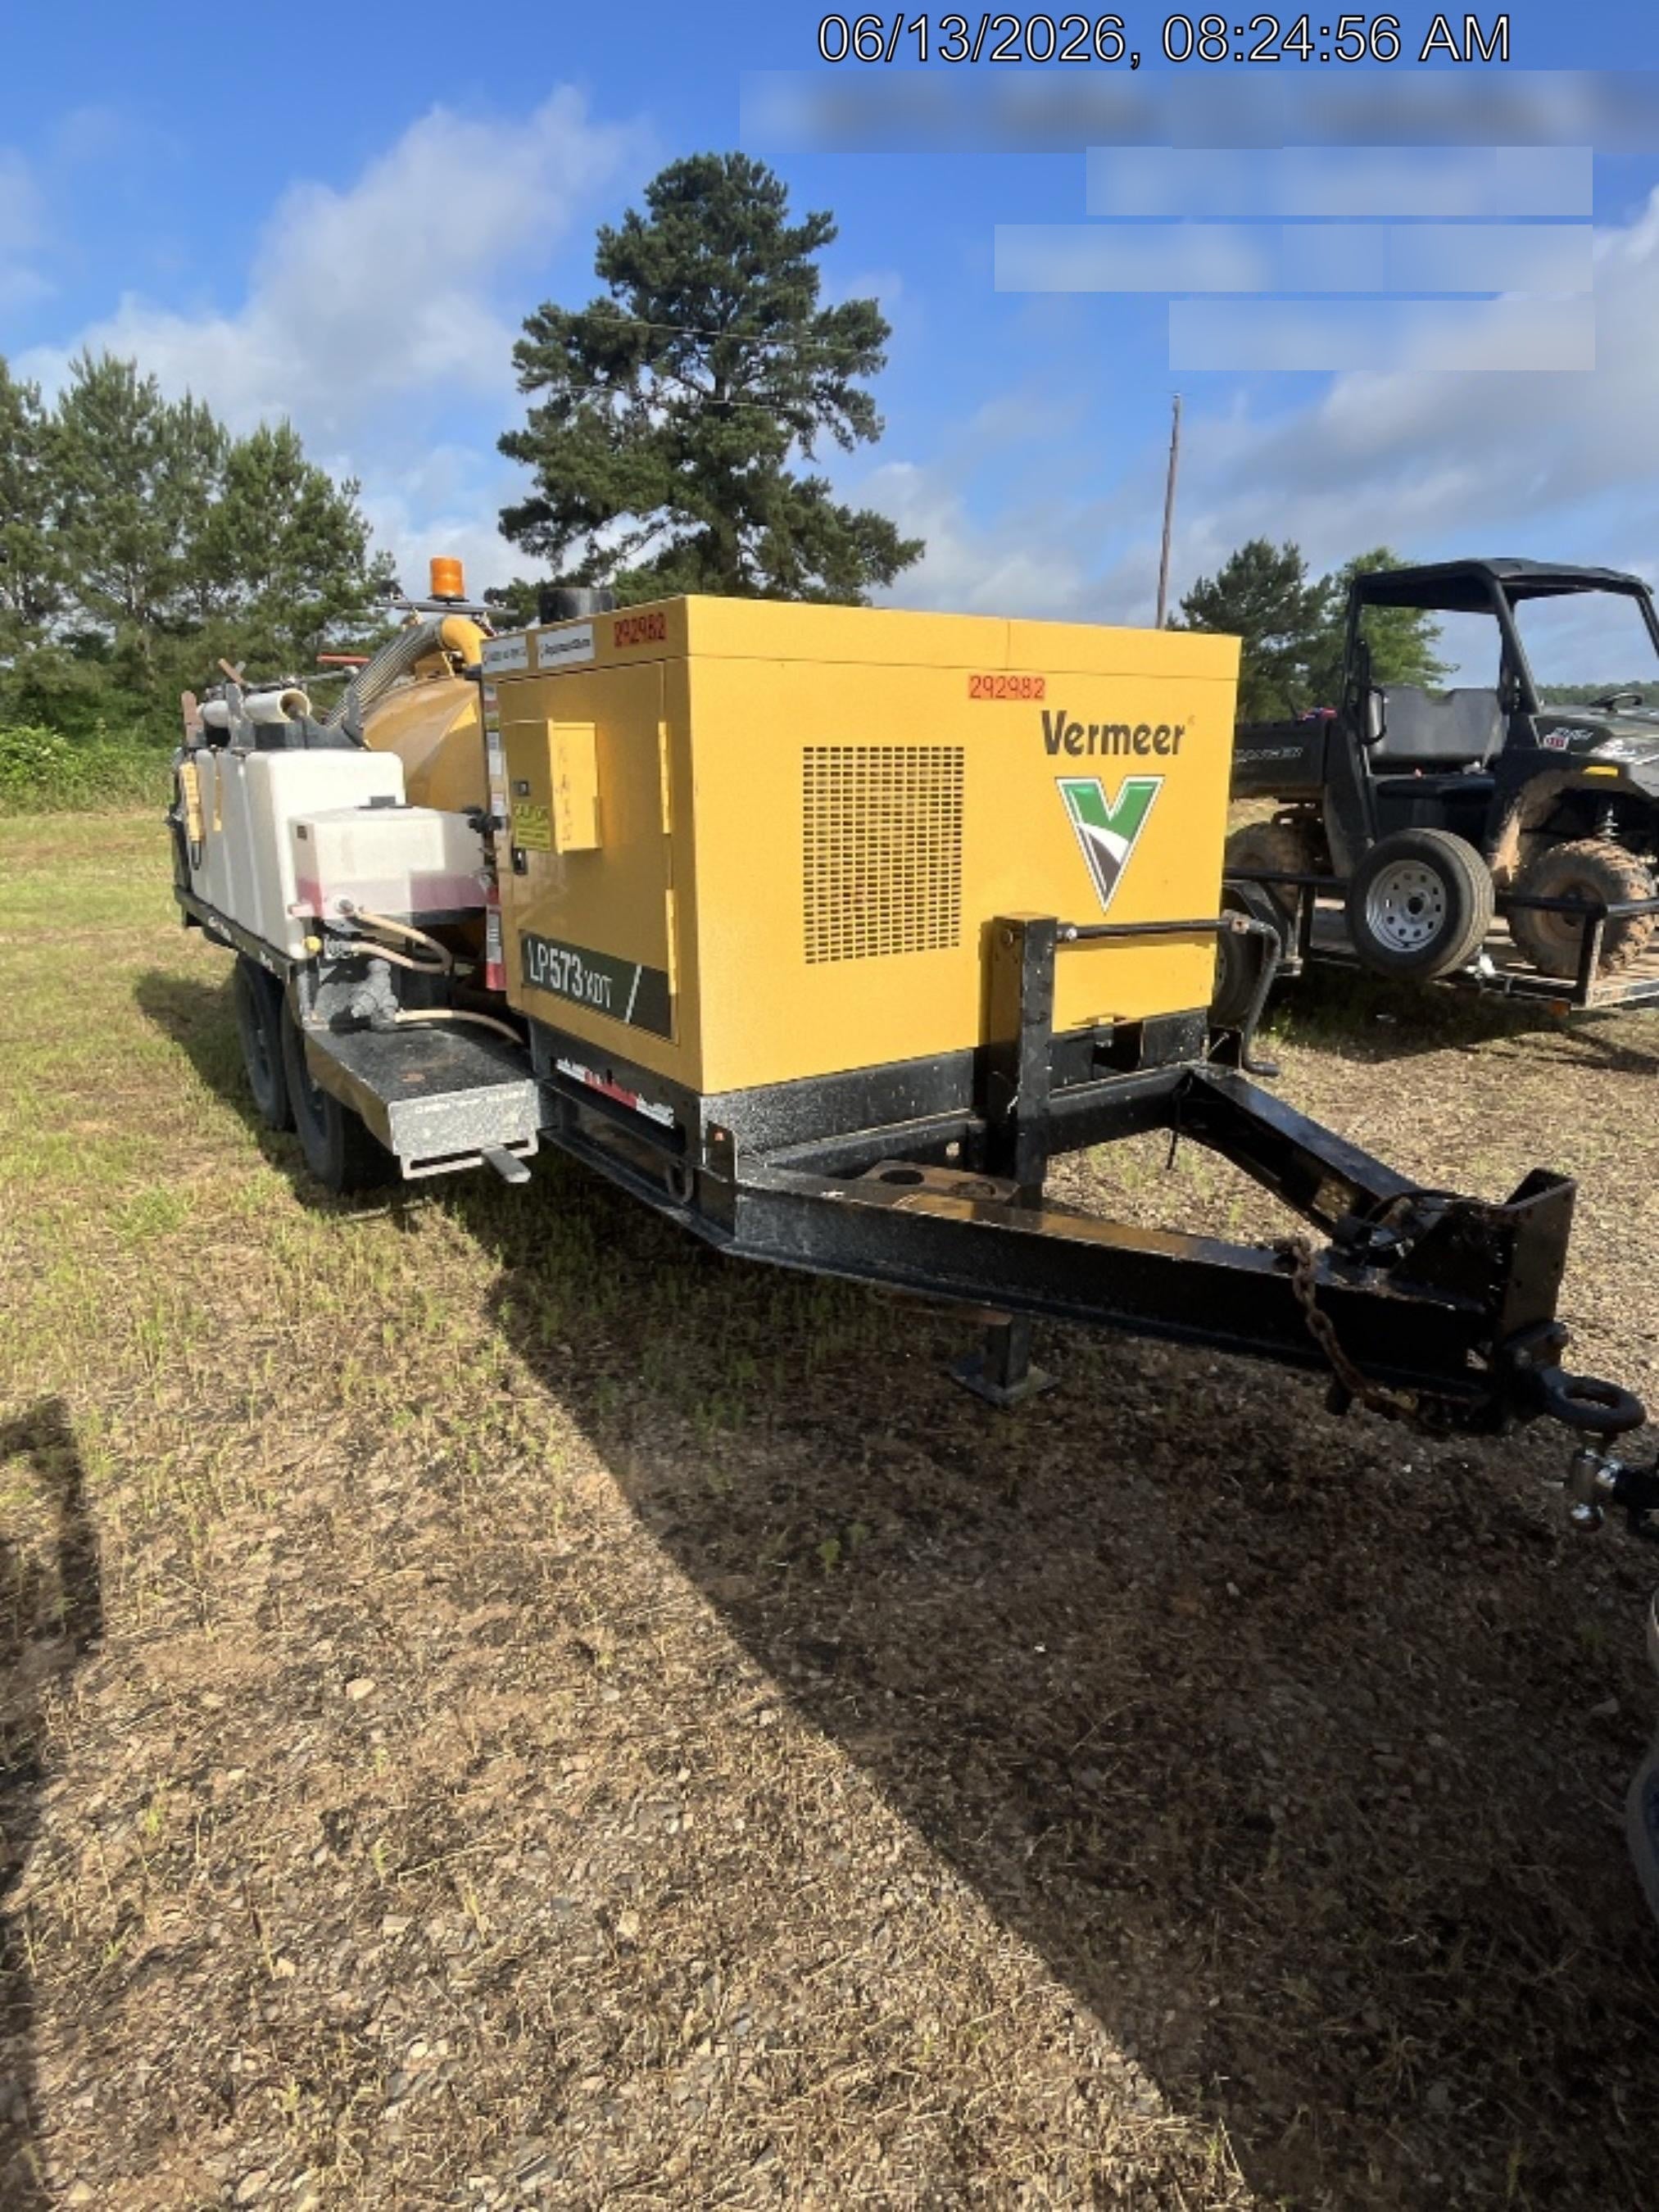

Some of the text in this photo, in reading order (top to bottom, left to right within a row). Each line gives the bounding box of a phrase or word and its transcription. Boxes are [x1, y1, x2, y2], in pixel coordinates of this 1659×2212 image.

[969, 676, 1045, 700] 292982
[1040, 709, 1185, 756] Vermeer
[512, 804, 551, 822] CAUTON
